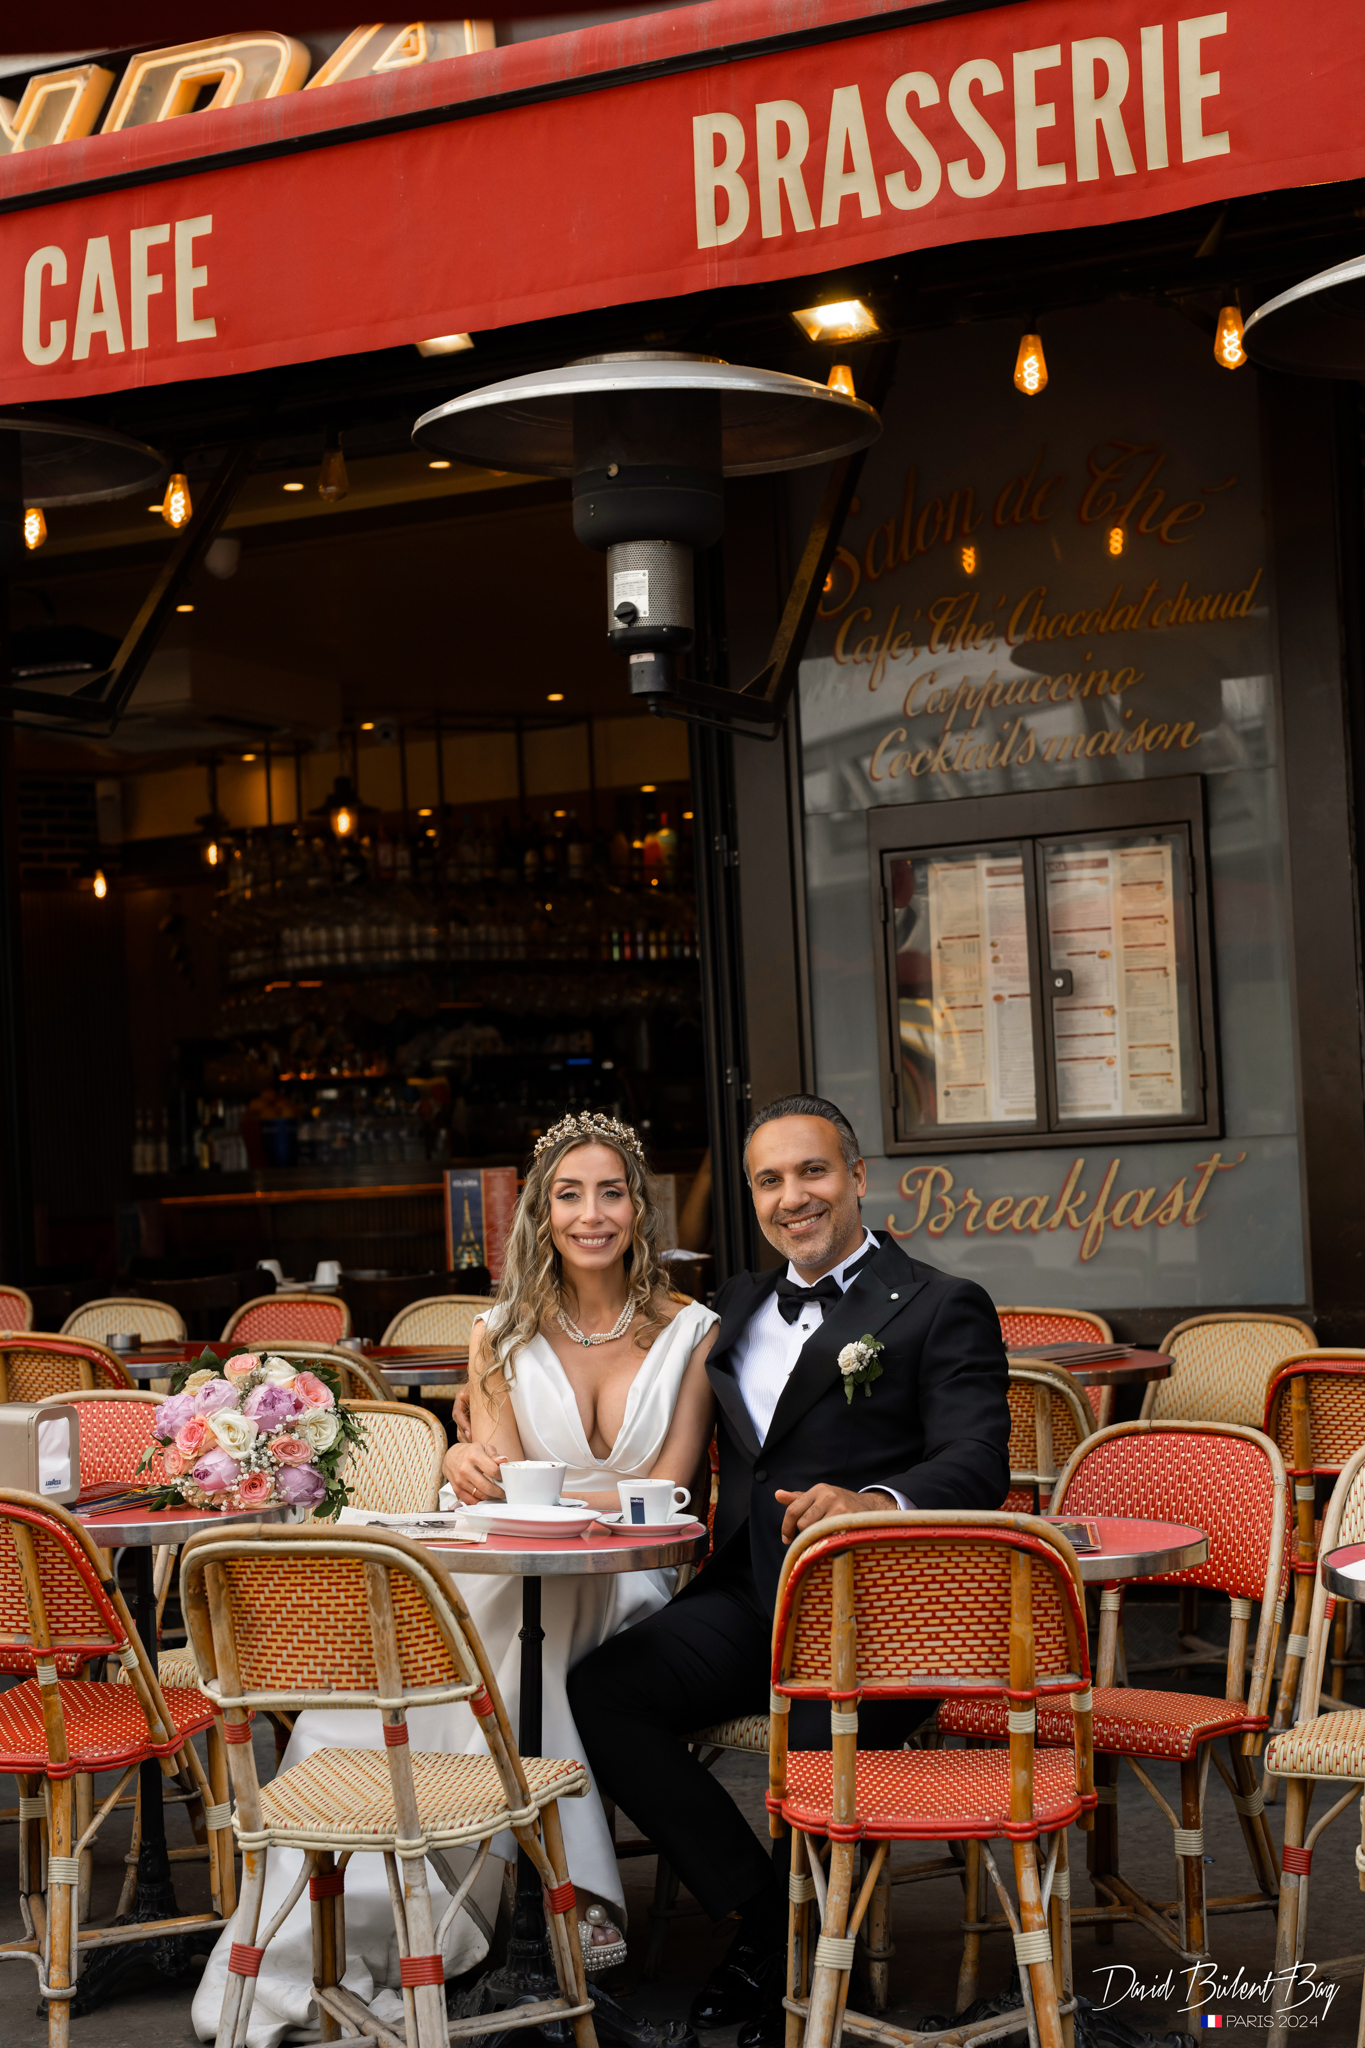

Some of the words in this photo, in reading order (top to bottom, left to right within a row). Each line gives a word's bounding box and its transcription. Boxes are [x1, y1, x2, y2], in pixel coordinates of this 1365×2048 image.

[692, 12, 1231, 250] BRASSERIE
[21, 214, 218, 367] CAFE
[815, 464, 983, 620] Salon
[992, 442, 1066, 531] de
[1004, 576, 1160, 649] Chocolat
[1149, 567, 1264, 628] chaud
[903, 651, 1145, 734] Cappuccino
[1042, 708, 1203, 764] maison
[886, 1151, 1246, 1264] Breakfast
